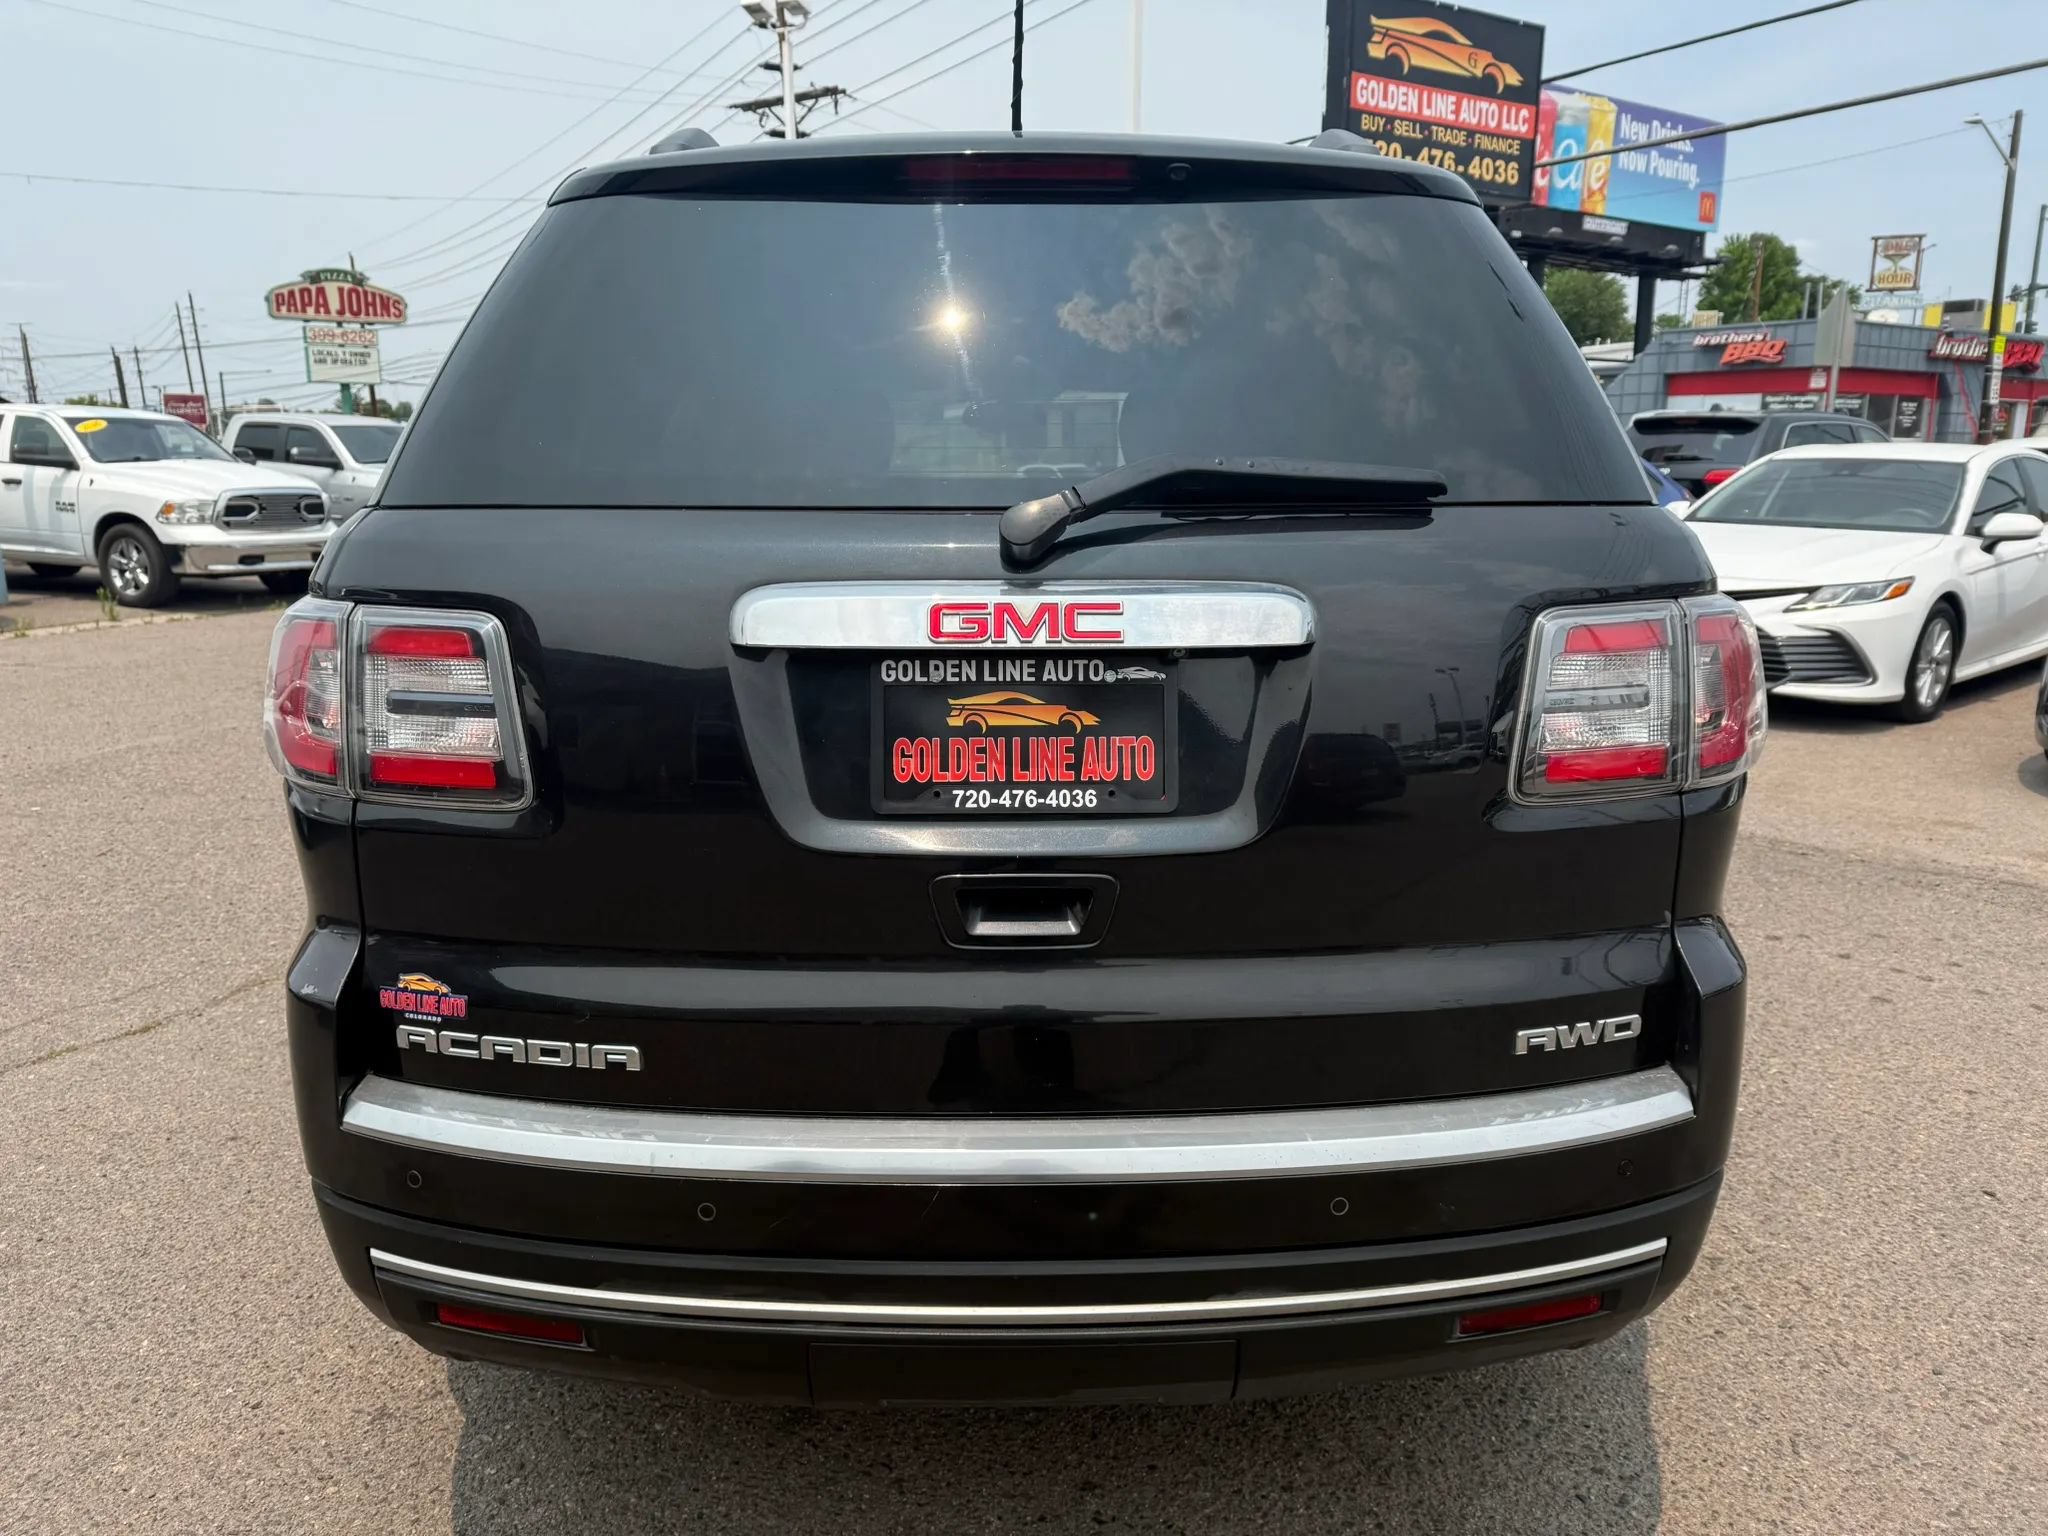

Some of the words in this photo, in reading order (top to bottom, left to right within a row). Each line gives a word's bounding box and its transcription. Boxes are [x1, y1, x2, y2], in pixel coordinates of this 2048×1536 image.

[1356, 77, 1419, 114] GOLDEN
[1422, 92, 1457, 121] LINE
[1459, 99, 1499, 129] AUTO
[1501, 107, 1530, 133] LLC
[1361, 114, 1386, 132] BUY
[1393, 119, 1423, 139] SELL
[1431, 125, 1468, 146] TRADE
[1474, 134, 1521, 155] FINANCE
[1620, 113, 1649, 143] New
[1618, 147, 1648, 173] Now
[1649, 149, 1700, 190] Pouring.
[1878, 272, 1912, 285] HOUR
[274, 286, 332, 316] PAPA
[1720, 340, 1787, 366] BBQ
[927, 601, 1124, 643] GMC
[880, 660, 976, 683] GOLDEN
[983, 660, 1036, 682] LINE
[1042, 660, 1104, 682] AUTO
[893, 736, 1006, 783] GOLDEN
[1012, 736, 1074, 782] LINE
[1081, 736, 1155, 782] AUTO
[952, 789, 1098, 808] 720-476-4036
[380, 989, 416, 1011] GOLDEN
[417, 994, 439, 1014] LINE
[440, 997, 466, 1017] AUTO
[405, 1013, 442, 1022] COLORADO
[395, 1024, 641, 1071] ACADIA
[1514, 1014, 1643, 1055] AWD
